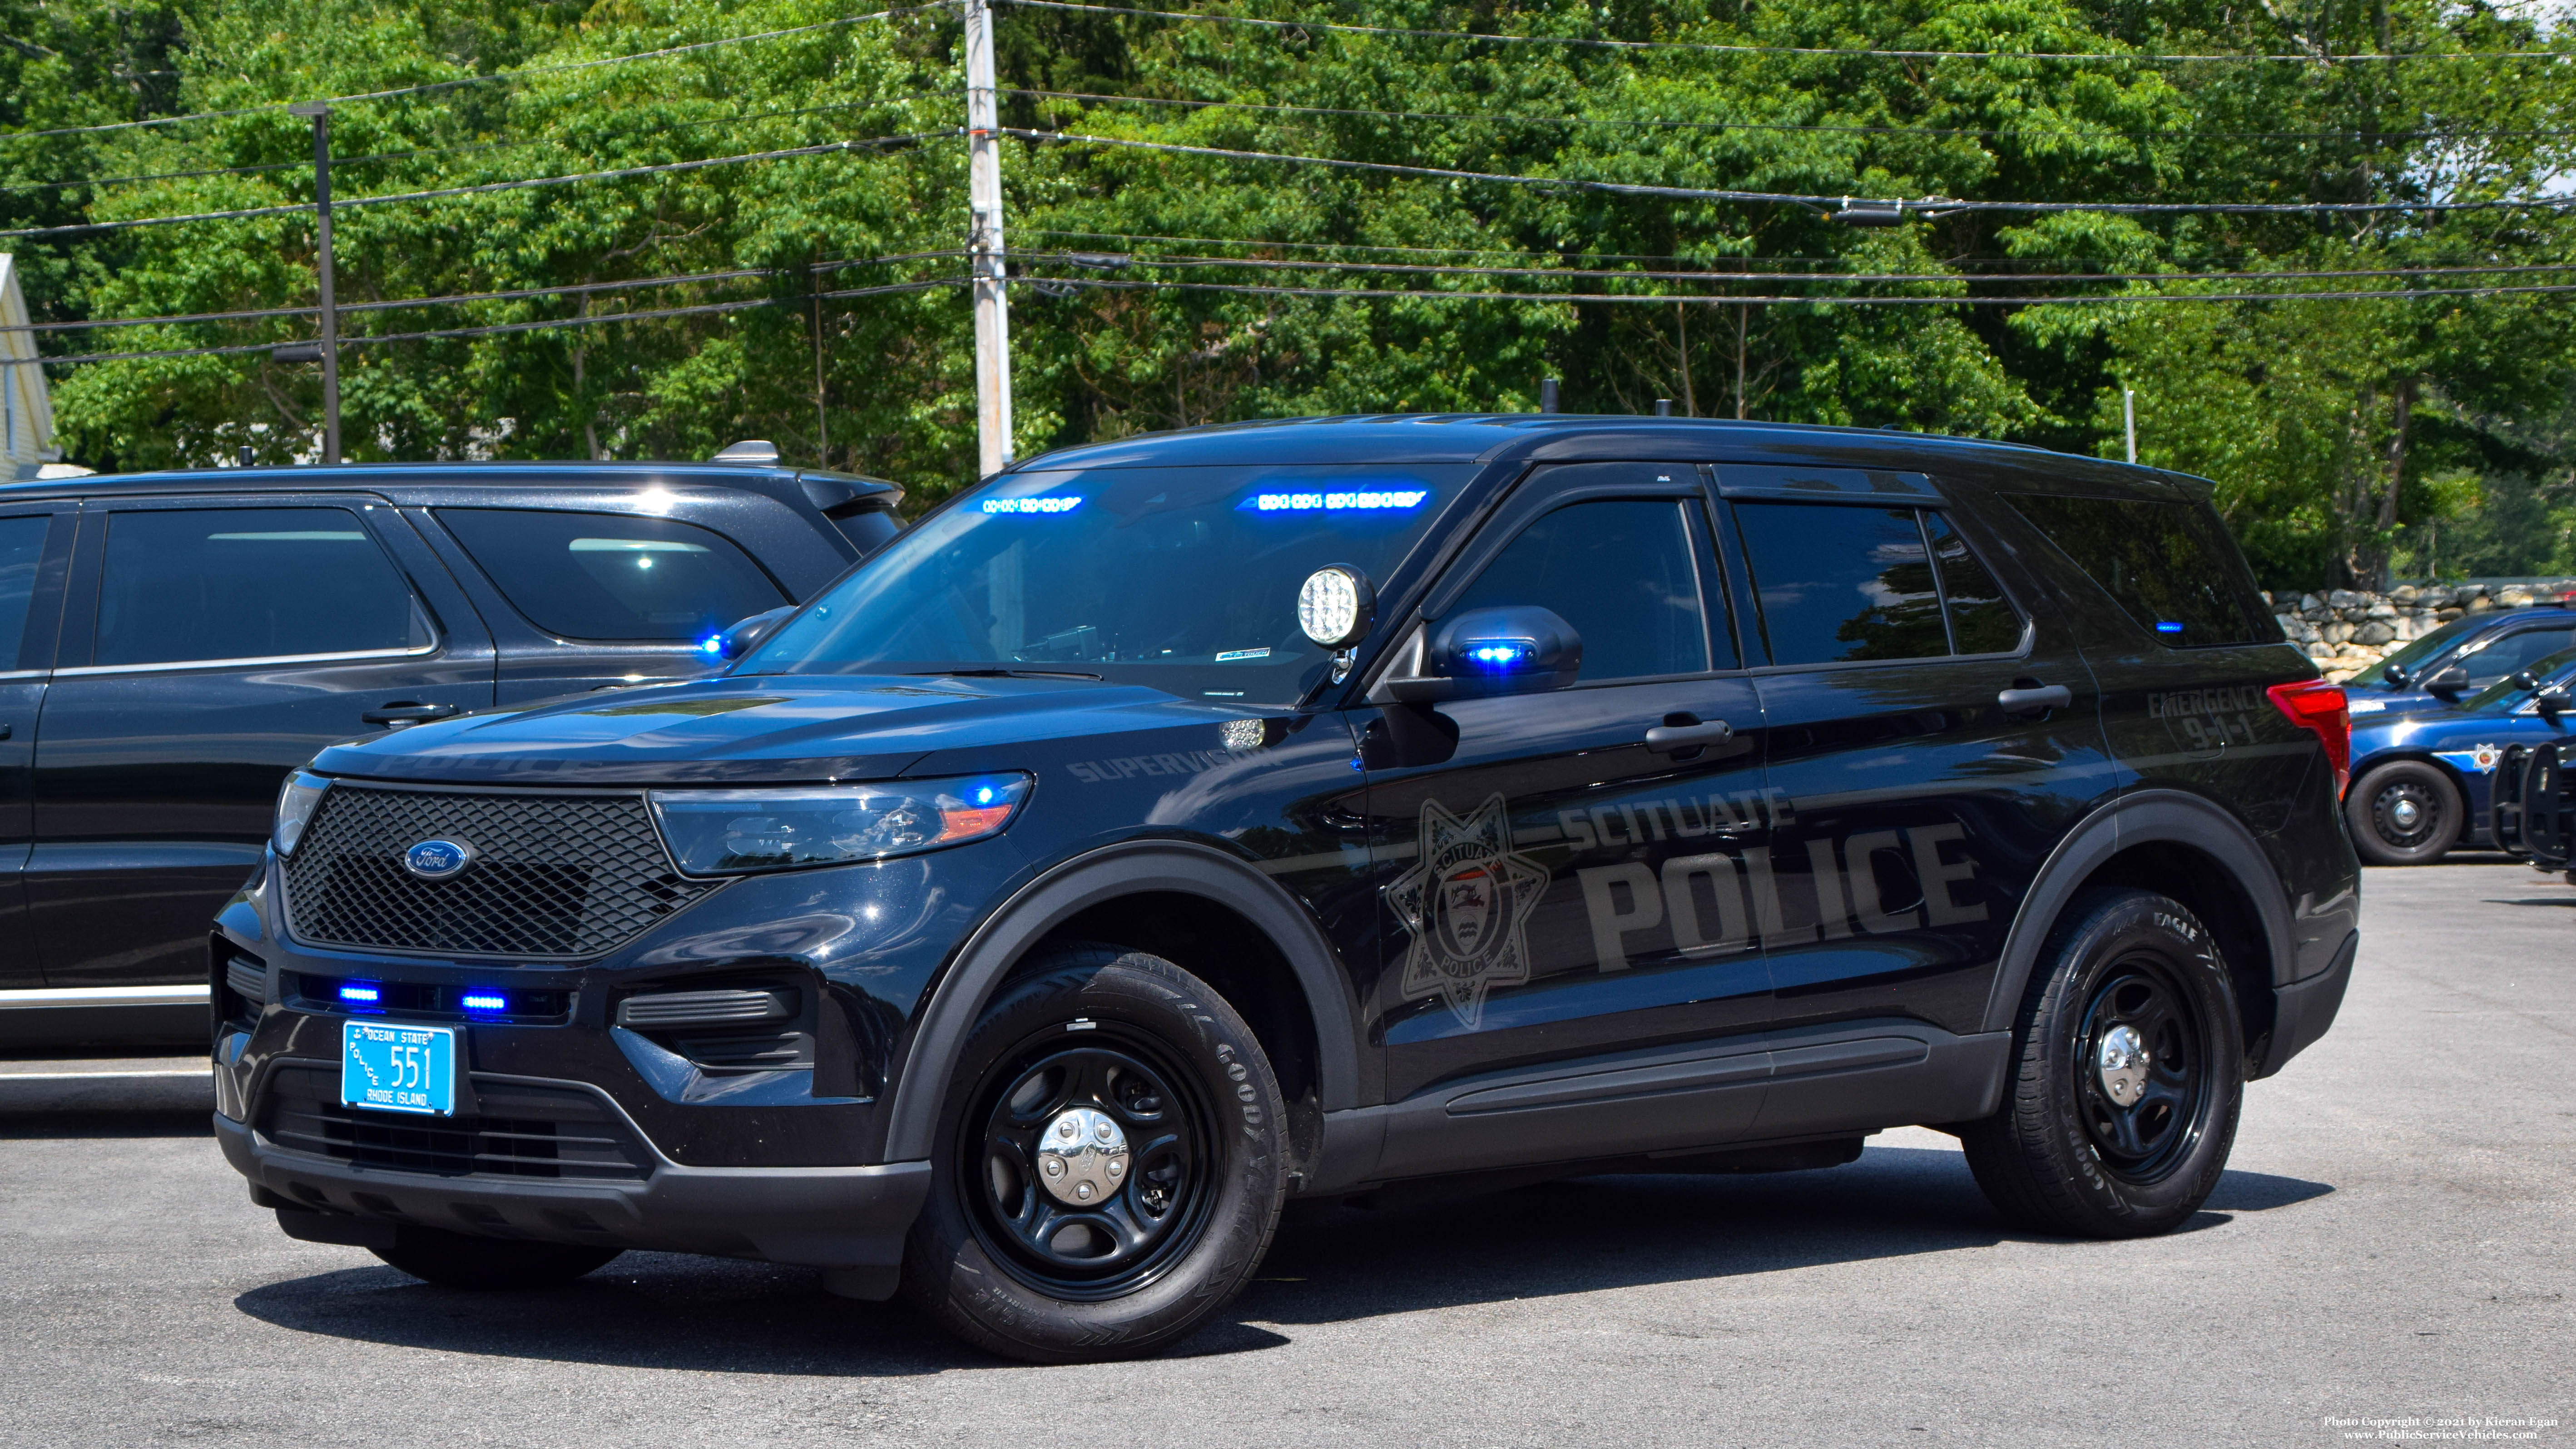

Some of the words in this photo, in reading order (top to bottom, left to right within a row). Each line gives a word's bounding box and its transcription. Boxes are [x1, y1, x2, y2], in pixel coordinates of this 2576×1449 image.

[2148, 685, 2265, 719] EMERGENCY
[2182, 713, 2259, 749] 9-1-1
[1066, 746, 1284, 783] SUPERVISOR
[1558, 786, 1796, 852] SCITUATE
[416, 847, 450, 867] Ford
[1434, 844, 1502, 880] SCITUATE
[1577, 822, 1989, 973] POLICE
[2153, 912, 2198, 942] EAGLE
[1441, 950, 1493, 976] POLICE
[368, 1029, 395, 1042] OCEAN
[401, 1032, 428, 1045] STATE
[350, 1042, 379, 1086] POLICE
[391, 1046, 431, 1090] 551
[367, 1088, 394, 1103] RHODE
[397, 1092, 427, 1107] ISLAND
